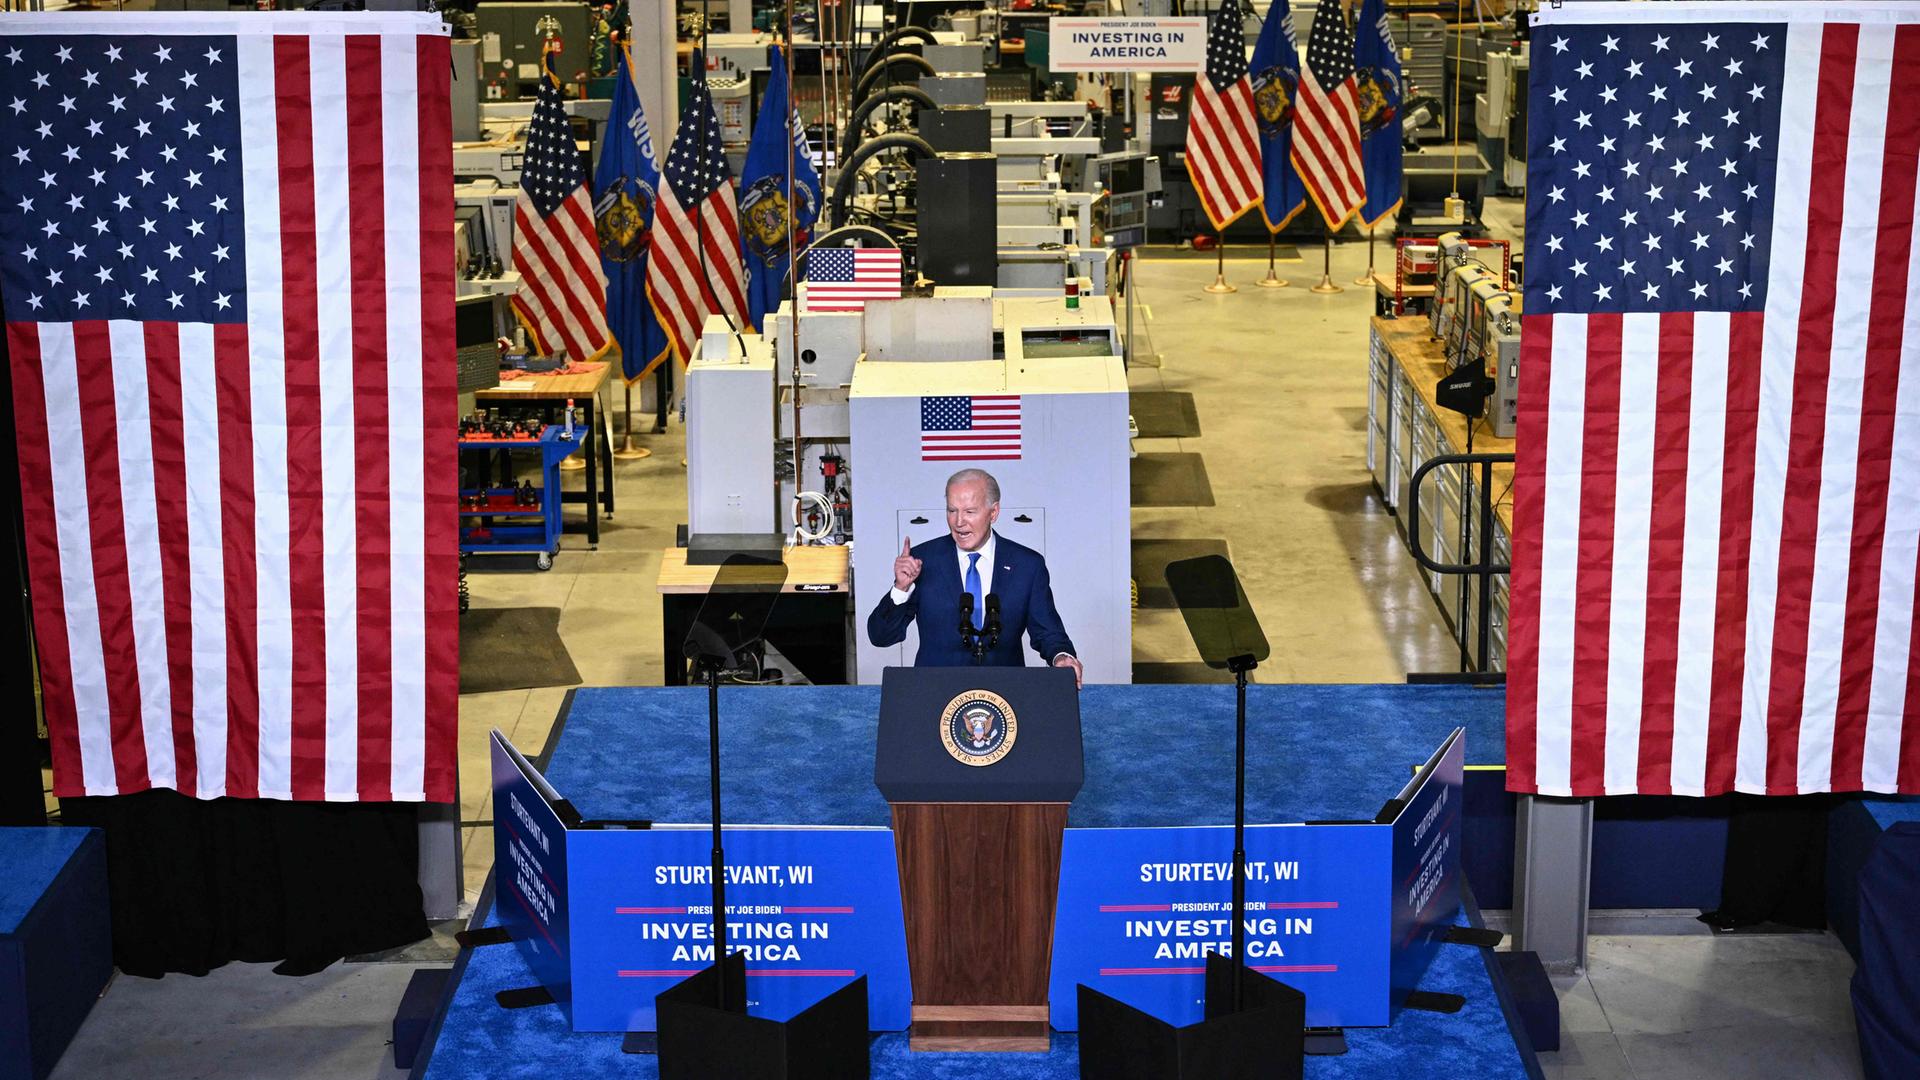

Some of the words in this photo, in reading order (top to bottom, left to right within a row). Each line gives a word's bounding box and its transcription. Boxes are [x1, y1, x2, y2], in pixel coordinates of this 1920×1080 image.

[1072, 33, 1163, 43] INVESTING
[1168, 33, 1184, 42] IN
[1090, 46, 1167, 57] AMERICA
[943, 692, 977, 726] PRESIDENT
[999, 701, 1015, 733] UNITED
[952, 747, 973, 762] SEAL
[985, 739, 1012, 762] STATES
[509, 840, 546, 899] INVESTING
[547, 890, 556, 914] IN
[788, 866, 813, 884] WI
[1274, 861, 1298, 880] WI
[516, 871, 549, 925] AMERICA
[1172, 903, 1220, 912] PRESIDENT
[1221, 902, 1233, 911] JO
[1243, 902, 1266, 911] IDEN
[688, 906, 735, 915] PRESINT
[736, 906, 754, 914] JOE
[755, 905, 782, 914] BIDEN
[801, 923, 829, 939] IN
[1285, 918, 1313, 935] IN
[1155, 941, 1284, 959] AMERCA
